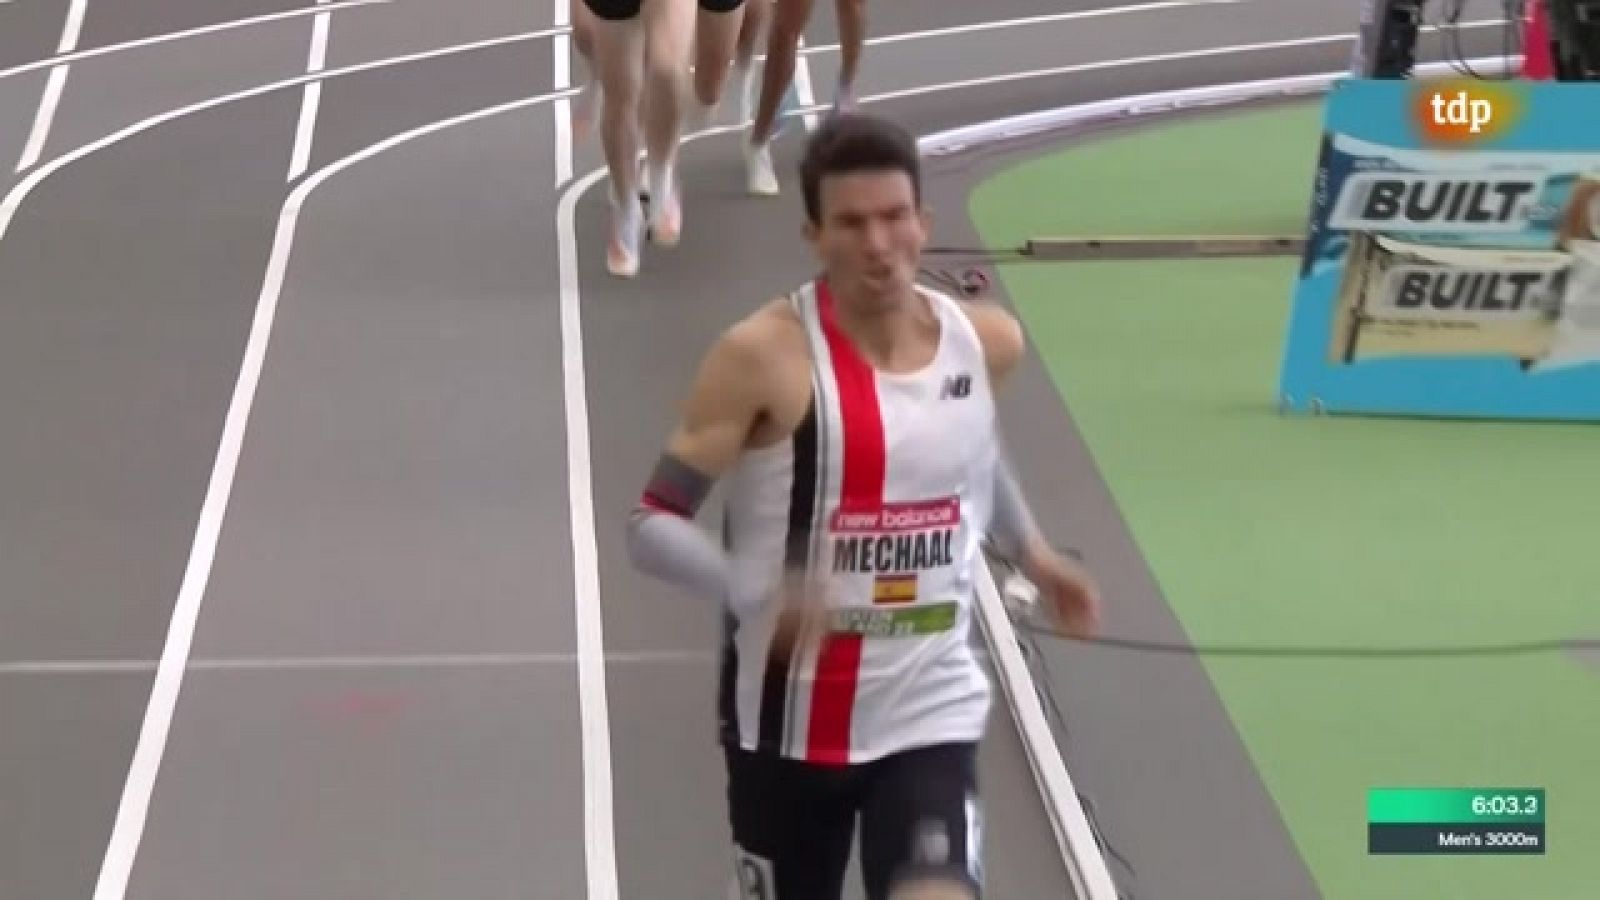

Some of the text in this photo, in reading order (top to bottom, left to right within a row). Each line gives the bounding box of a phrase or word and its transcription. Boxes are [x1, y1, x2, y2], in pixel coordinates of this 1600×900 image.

[1361, 179, 1535, 223] BUILT
[1395, 271, 1544, 311] BUILT
[833, 529, 954, 573] MECHAAL
